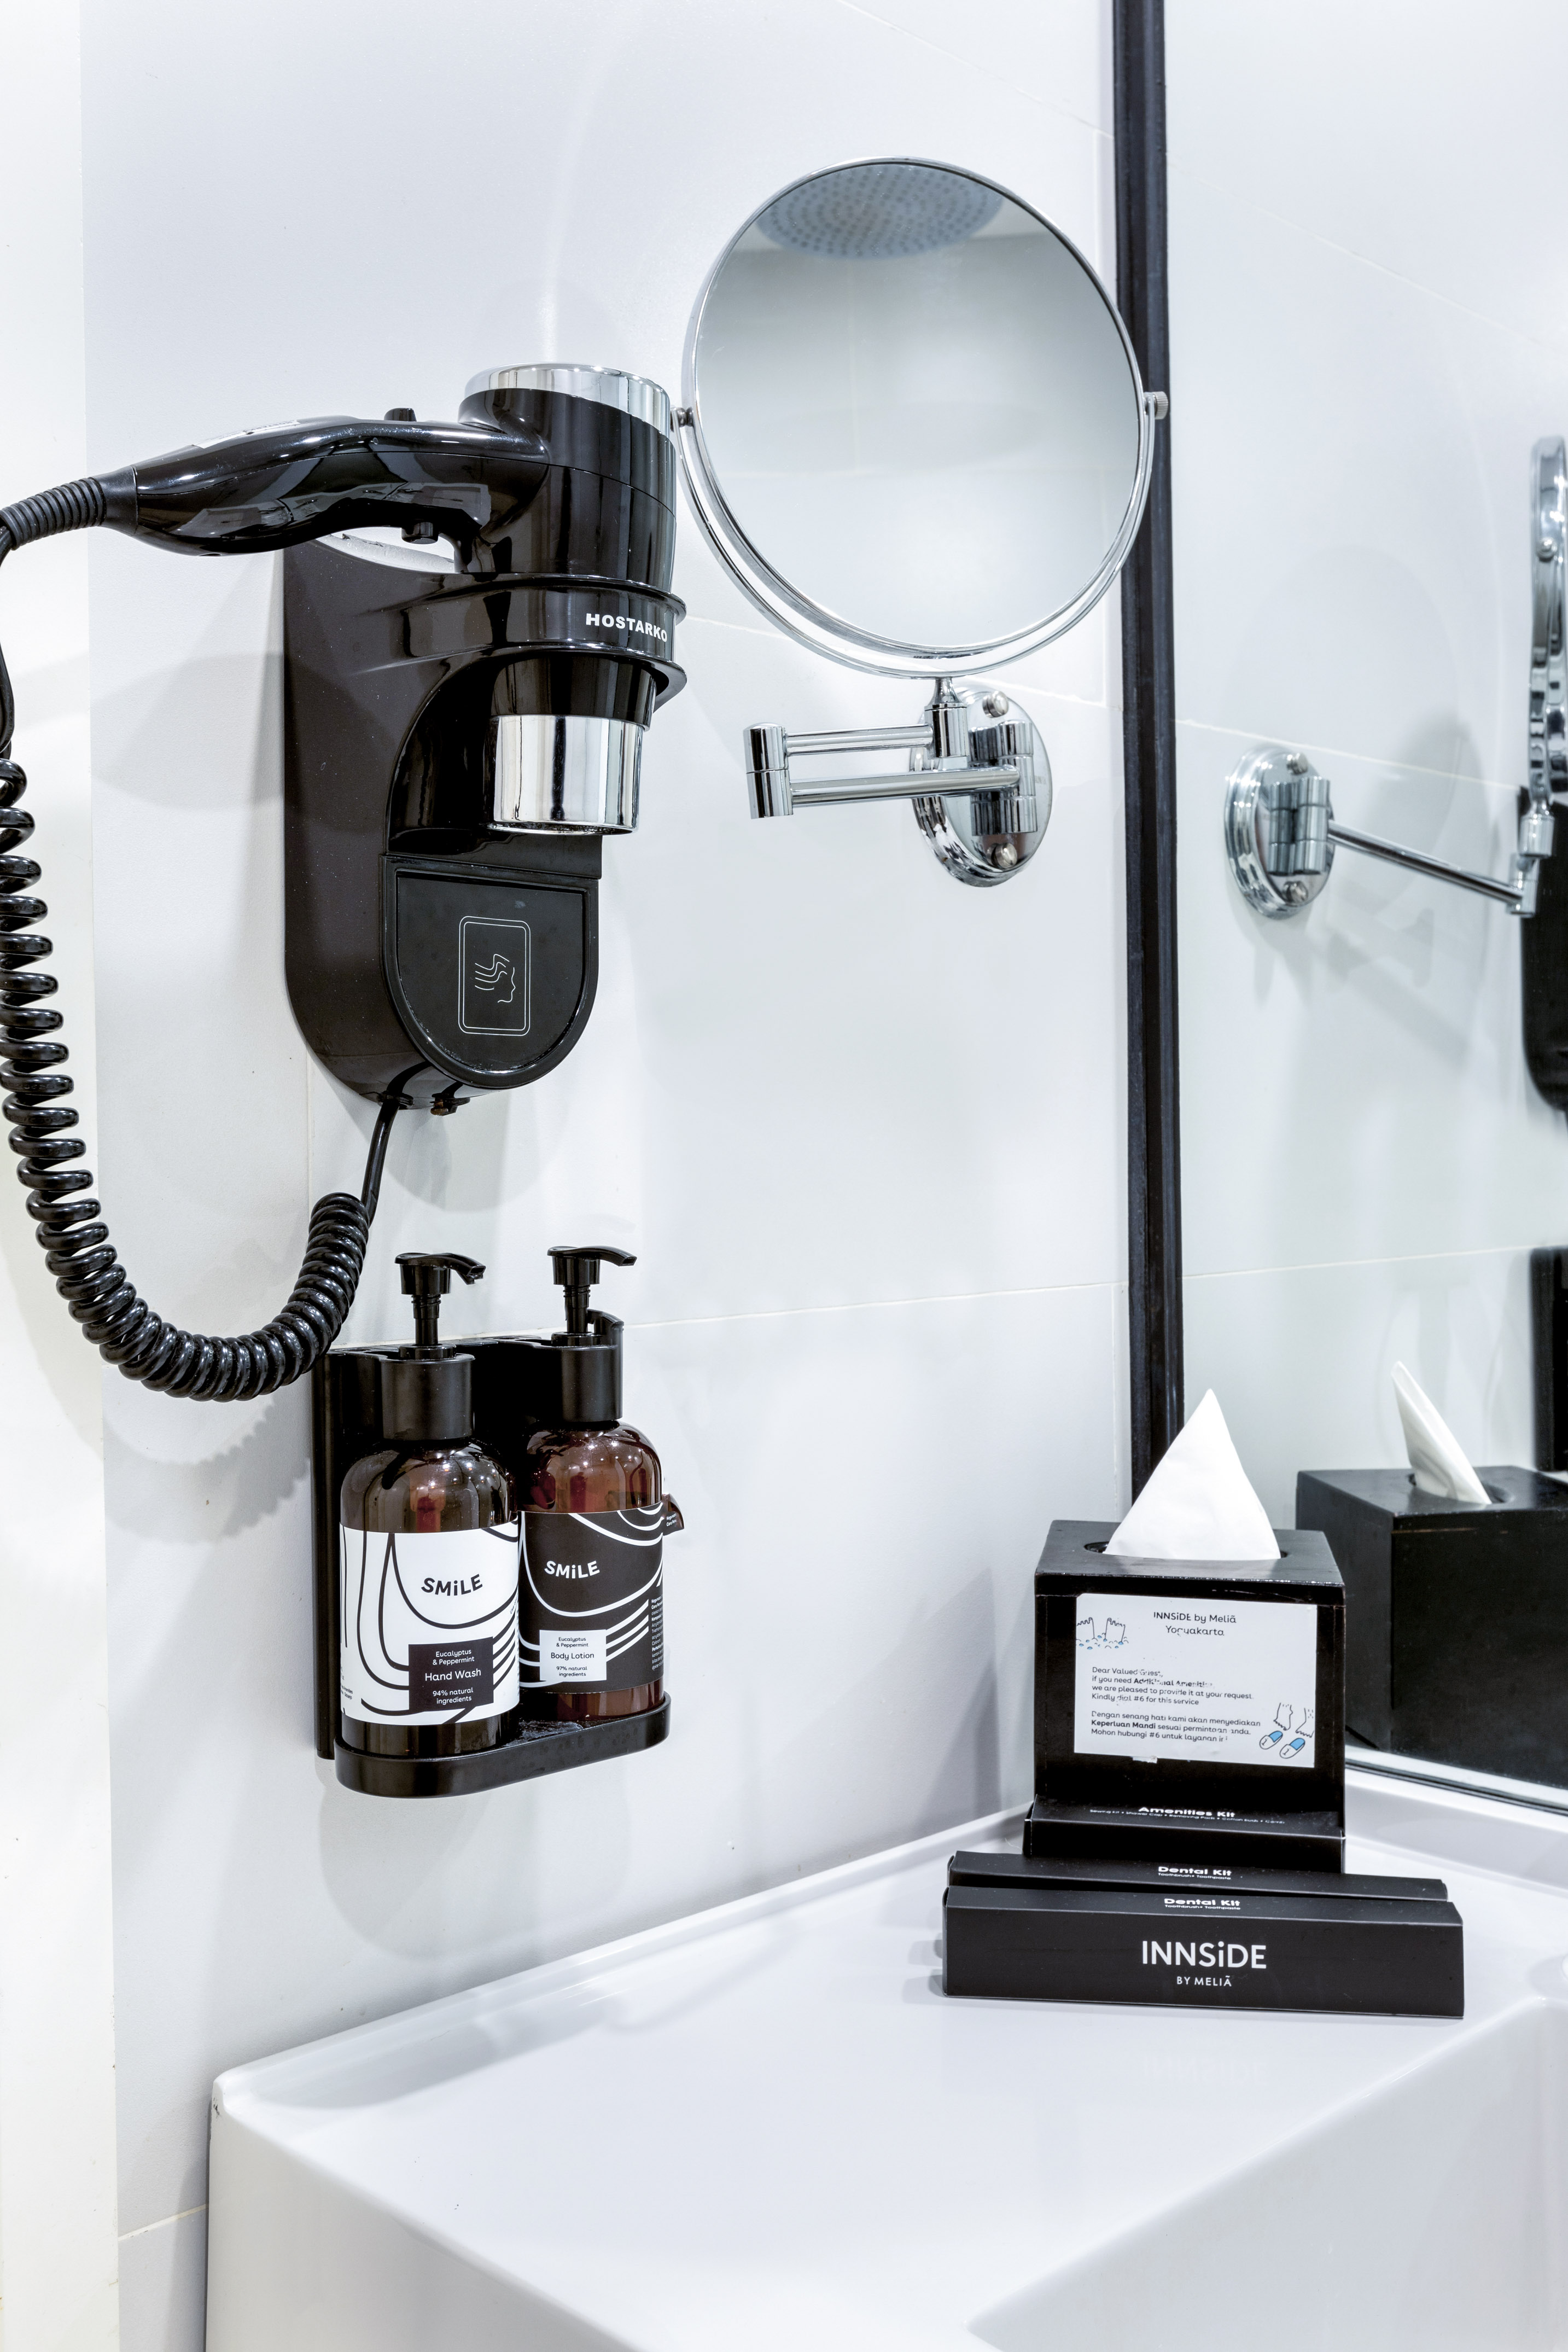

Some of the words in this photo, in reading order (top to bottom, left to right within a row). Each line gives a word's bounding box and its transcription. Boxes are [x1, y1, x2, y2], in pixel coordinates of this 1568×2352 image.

[586, 613, 667, 642] HOSTARKO
[544, 1561, 600, 1579] SMiLE
[421, 1574, 483, 1596] SMiLE
[1153, 1611, 1191, 1621] INNSiDE
[1194, 1614, 1206, 1623] by
[439, 1656, 475, 1666] Peppermint
[551, 1652, 569, 1661] Body
[425, 1672, 452, 1681] Hand
[454, 1668, 481, 1679] Wash
[449, 1687, 474, 1695] natural
[436, 1696, 472, 1705] ingredients
[1092, 1693, 1115, 1702] Kindly
[1117, 1730, 1147, 1739] hubungi
[1138, 1807, 1213, 1816] Amenities
[1158, 1866, 1208, 1874] Dental
[1143, 1941, 1267, 1969] INNSiDE
[1176, 1976, 1190, 1985] BY
